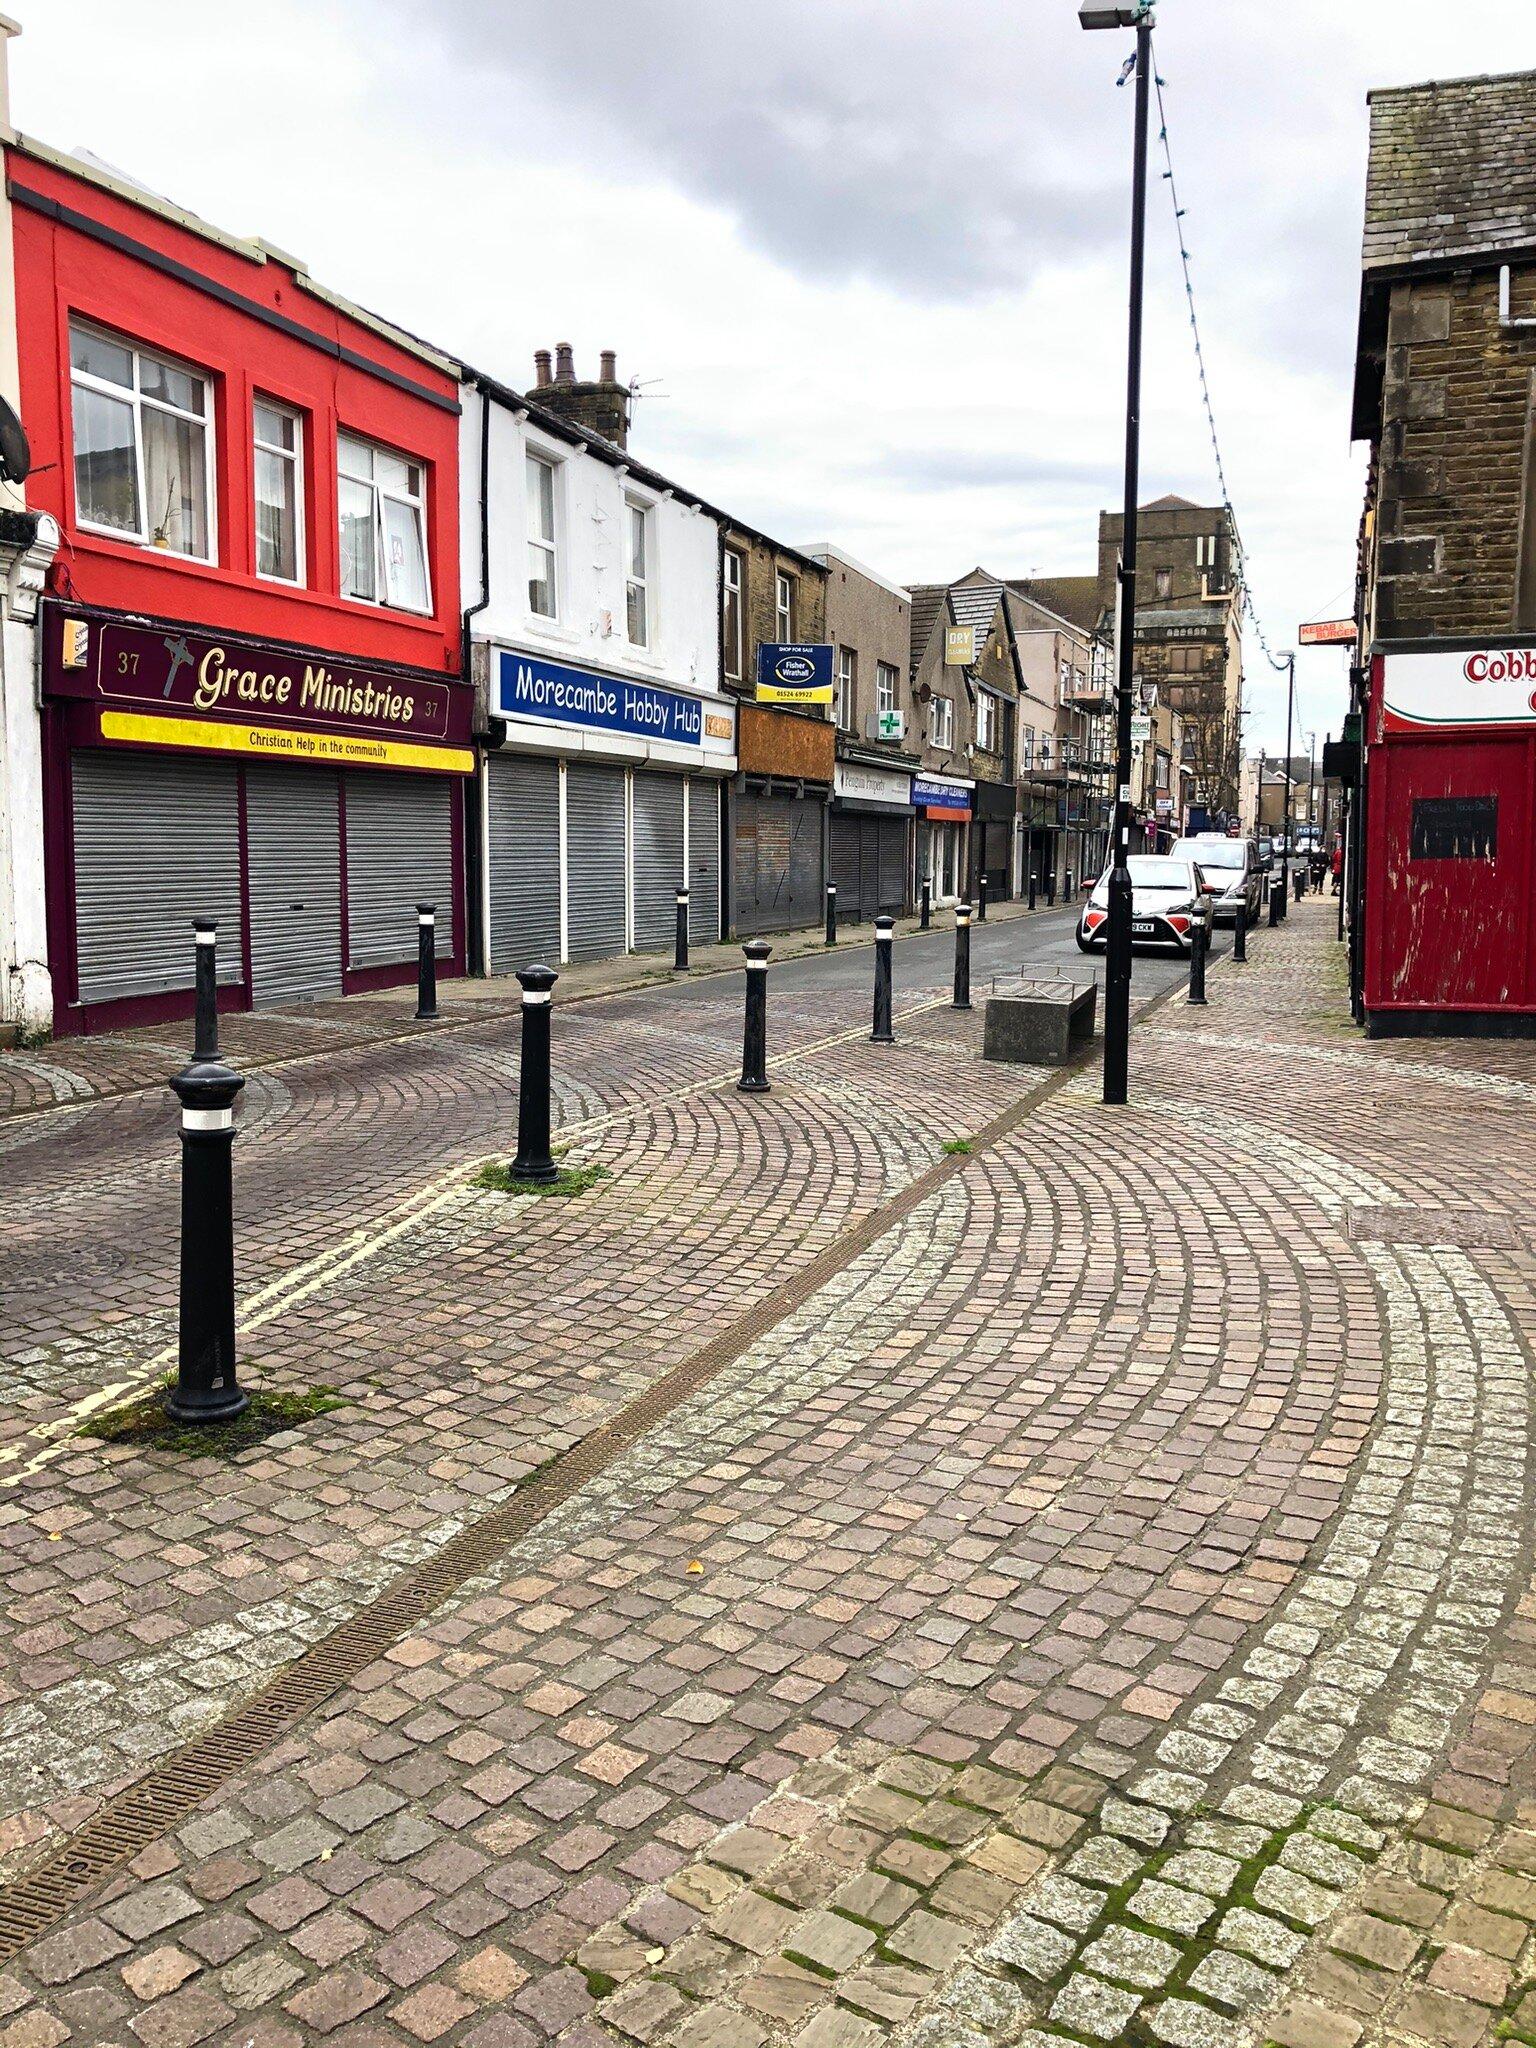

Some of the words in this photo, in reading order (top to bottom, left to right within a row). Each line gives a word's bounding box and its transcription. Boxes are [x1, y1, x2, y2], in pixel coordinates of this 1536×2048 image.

[949, 632, 969, 645] DRY
[1302, 624, 1336, 634] KEBAB
[1316, 628, 1357, 639] BURGER
[118, 652, 139, 675] 37
[193, 648, 292, 710] Grace
[300, 665, 414, 722] Ministries
[515, 664, 617, 715] Morecambe
[624, 688, 669, 733] Hobby
[674, 701, 700, 733] Hub
[424, 701, 438, 718] 37
[250, 732, 293, 748] Christian
[297, 737, 315, 754] Help
[319, 740, 327, 752] in
[330, 740, 343, 754] the
[345, 744, 387, 759] community
